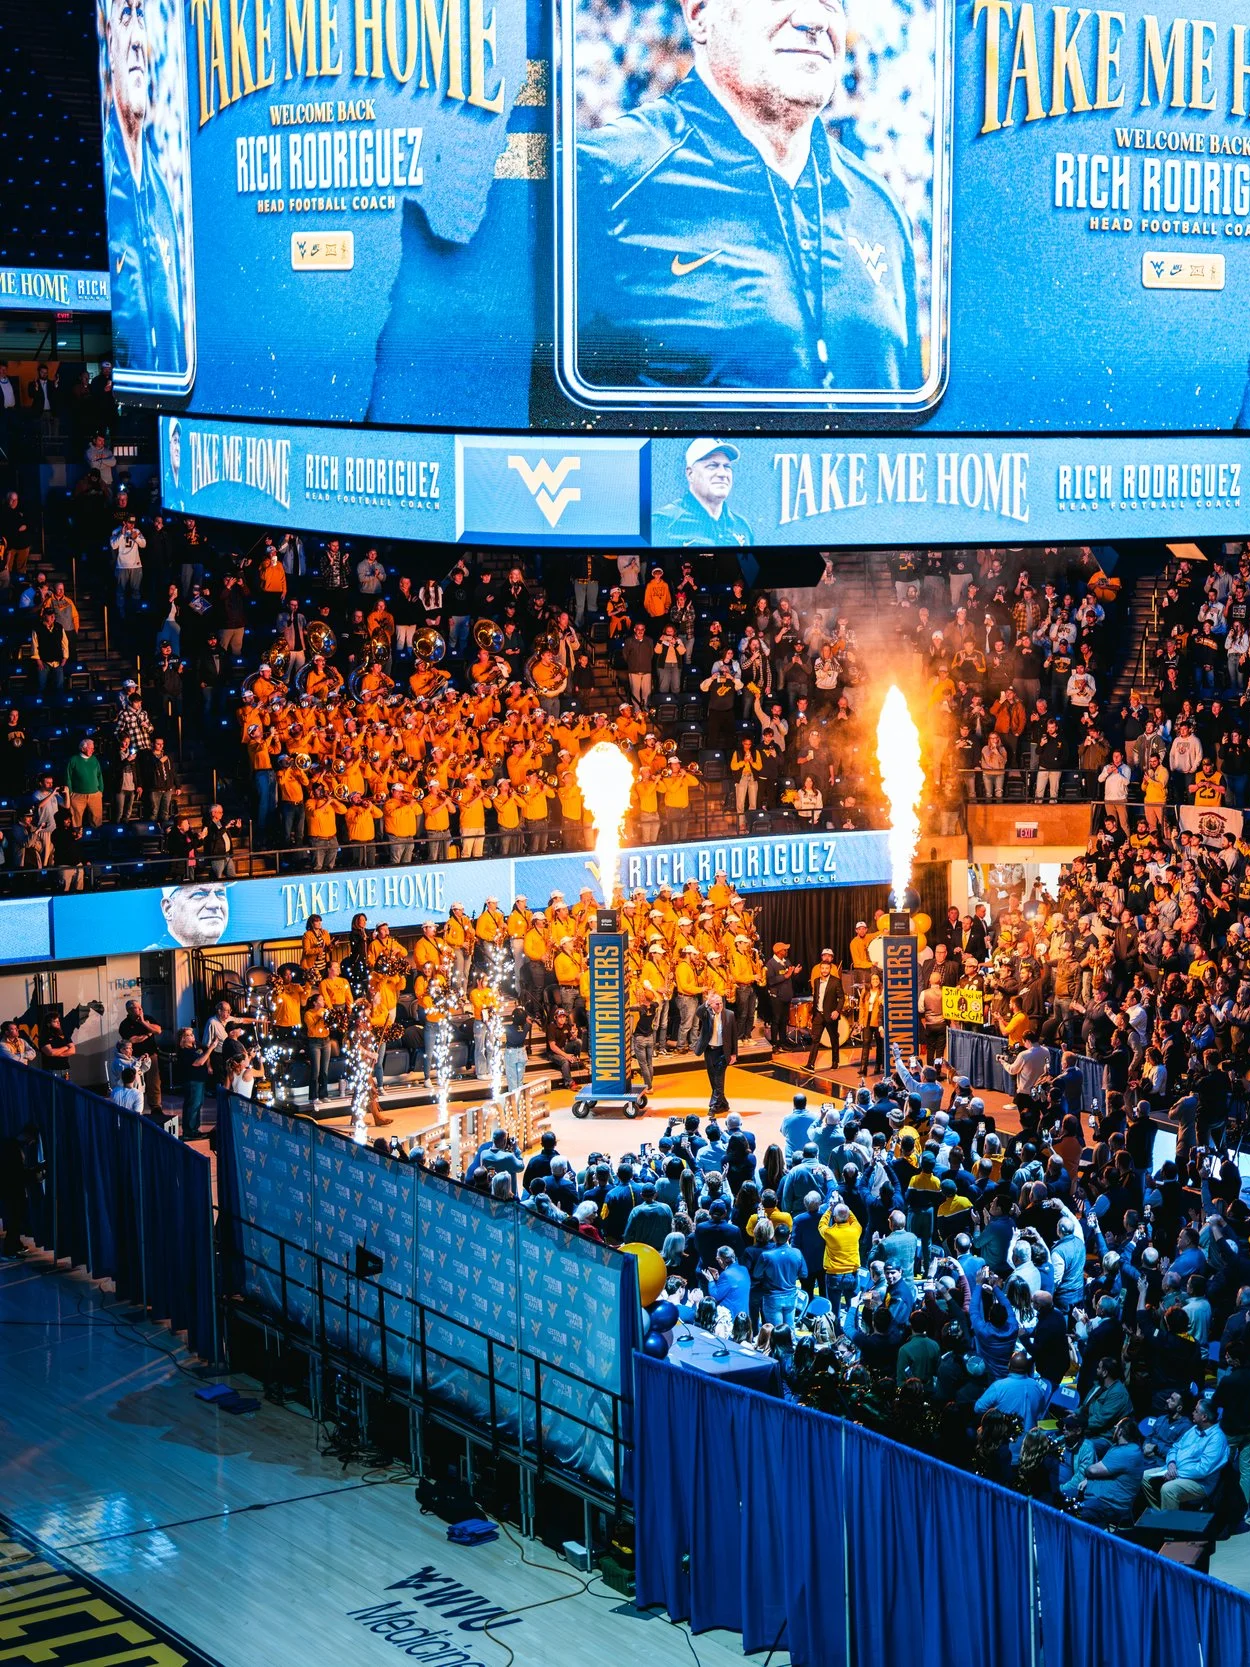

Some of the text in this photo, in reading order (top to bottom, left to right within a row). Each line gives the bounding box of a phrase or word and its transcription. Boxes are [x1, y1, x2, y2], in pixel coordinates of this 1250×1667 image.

[190, 0, 506, 128] TAKE ME HOME
[973, 0, 1126, 134] TAKE
[1140, 14, 1218, 111] ME
[269, 99, 376, 126] WELCOME BACK
[236, 127, 424, 193] RICH RODRIGUEZ
[1114, 127, 1205, 153] WELCOME
[257, 195, 396, 214] HEAD FOOTBALL COACH
[1054, 152, 1131, 210] RICH
[1089, 217, 1133, 232] HEAD
[1141, 218, 1218, 236] FOOTBALL
[0, 272, 107, 305] E HOME RICH
[190, 431, 440, 510] TAKE ME HOME RICH RODRIGUEZ
[773, 452, 867, 525] TAKE
[876, 452, 928, 506] ME
[936, 452, 1030, 524] HOME
[1059, 464, 1112, 500] RICH
[1122, 463, 1241, 499] RODRIGUEZ
[305, 491, 440, 510] HEAD FOOTBALL COACH
[1059, 499, 1241, 511] HEAD FOOTBALL COACH
[1020, 829, 1034, 838] EXIT
[629, 840, 837, 888] RICH RODRIGUEZ
[782, 873, 838, 885] COACH
[281, 871, 447, 927] TAKE ME HOME
[593, 945, 621, 1082] MOUNTAINEERS
[886, 944, 913, 1076] OUNTAINEERS
[412, 1582, 524, 1632] WVU
